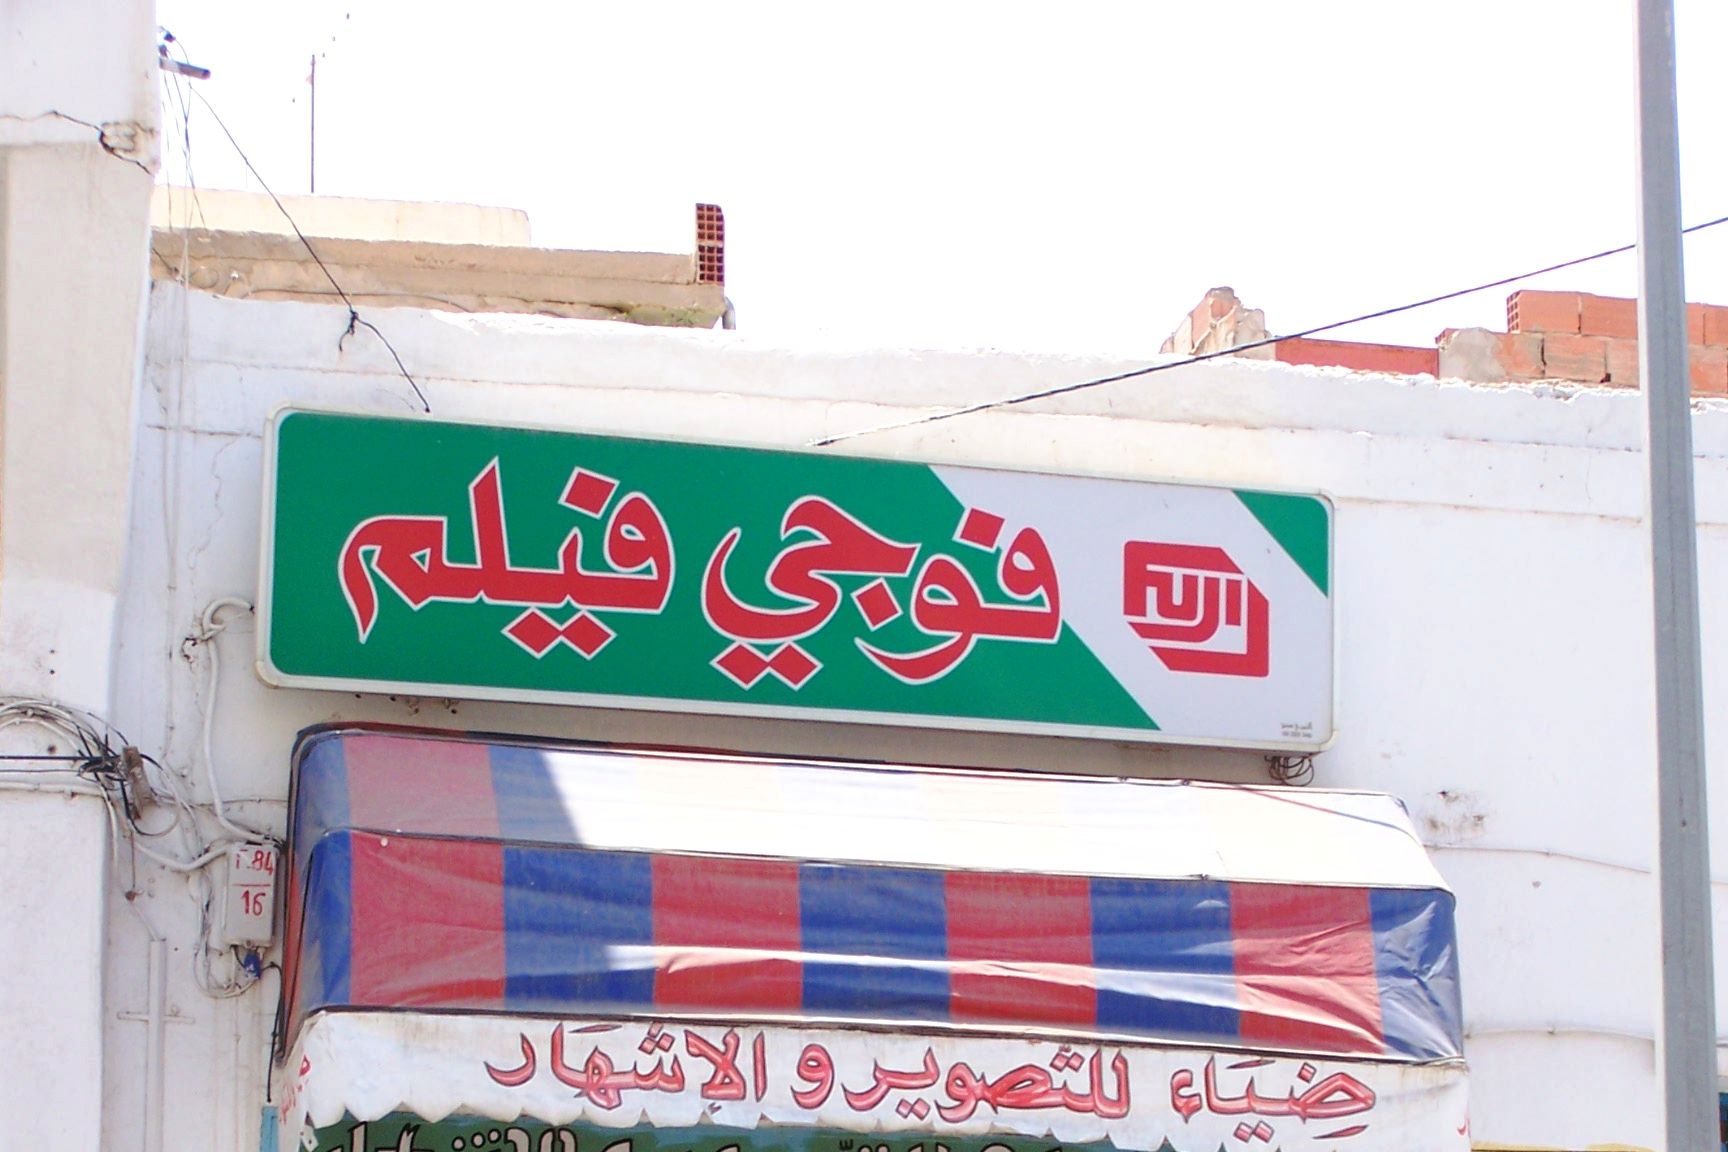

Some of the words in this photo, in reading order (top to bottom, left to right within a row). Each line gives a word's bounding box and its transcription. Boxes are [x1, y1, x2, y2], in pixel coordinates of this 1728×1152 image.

[337, 455, 676, 661] فيلم
[700, 494, 1062, 690] فوجي
[1123, 540, 1270, 678] FUJI
[241, 890, 266, 916] 16
